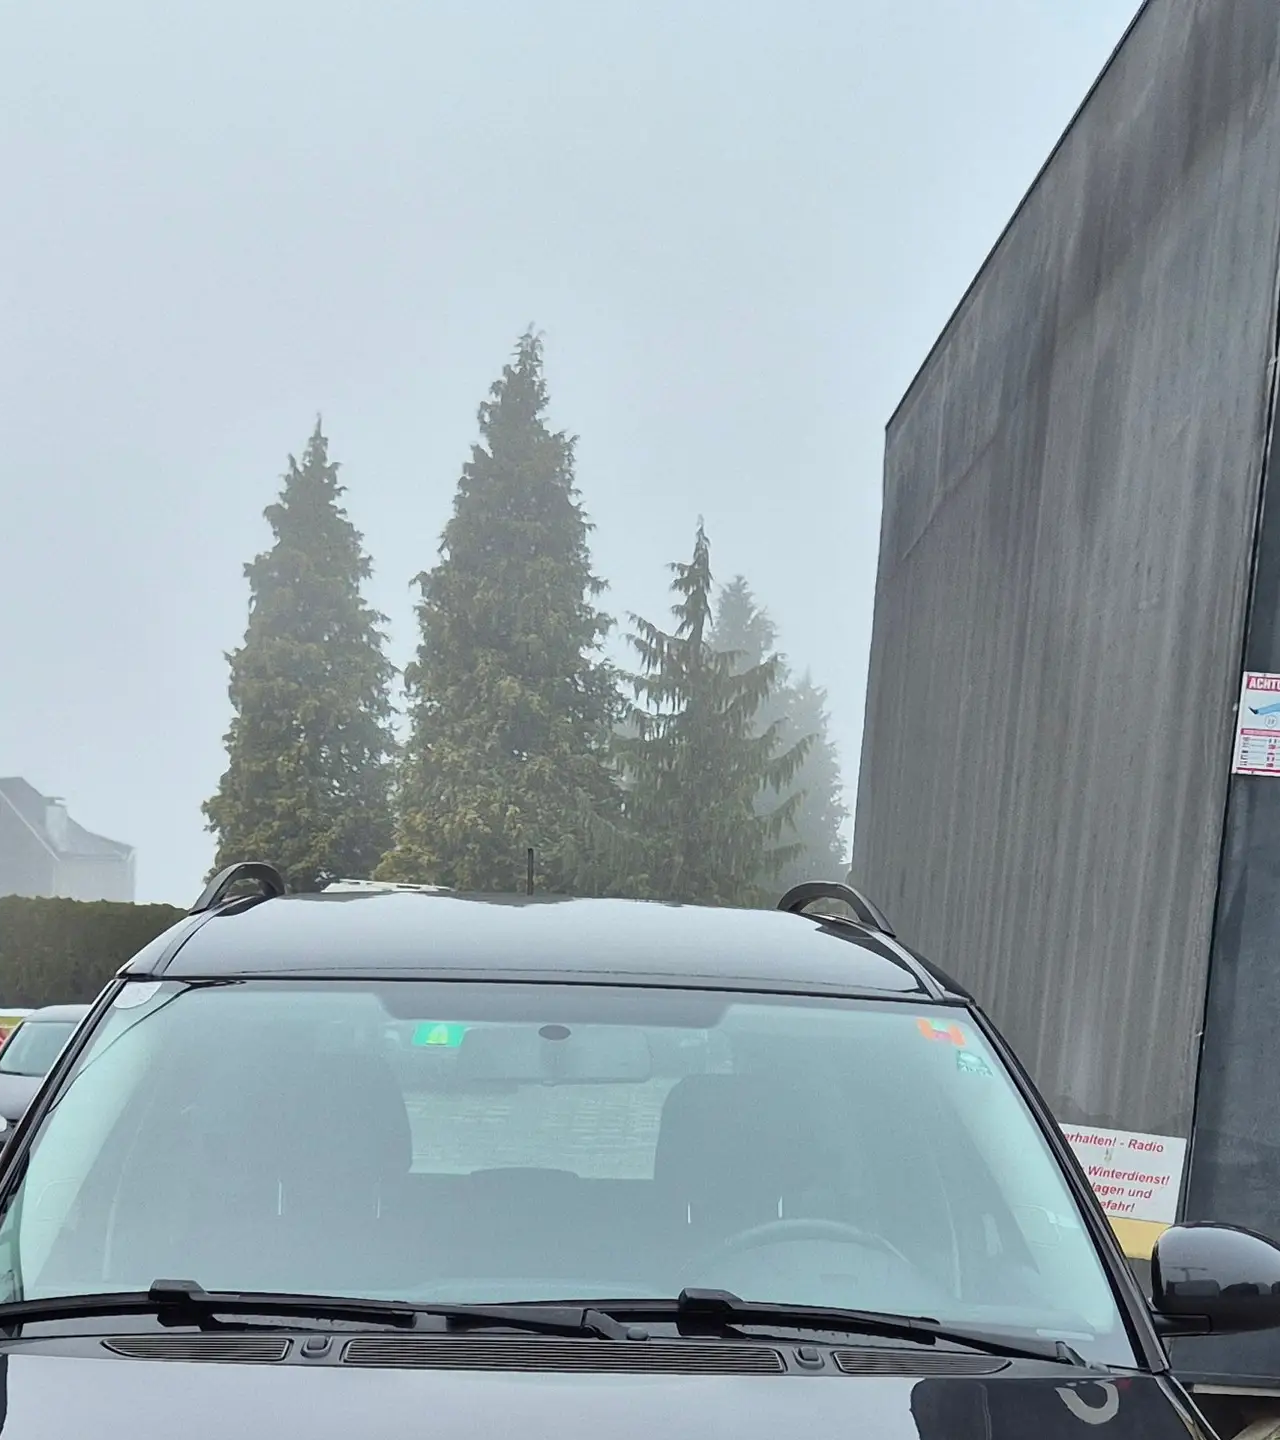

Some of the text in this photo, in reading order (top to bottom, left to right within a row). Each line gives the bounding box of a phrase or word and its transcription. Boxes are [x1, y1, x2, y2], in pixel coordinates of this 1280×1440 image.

[1128, 1138, 1164, 1153] Radio
[1088, 1165, 1171, 1186] Winterdienst!
[1128, 1189, 1153, 1199] und
